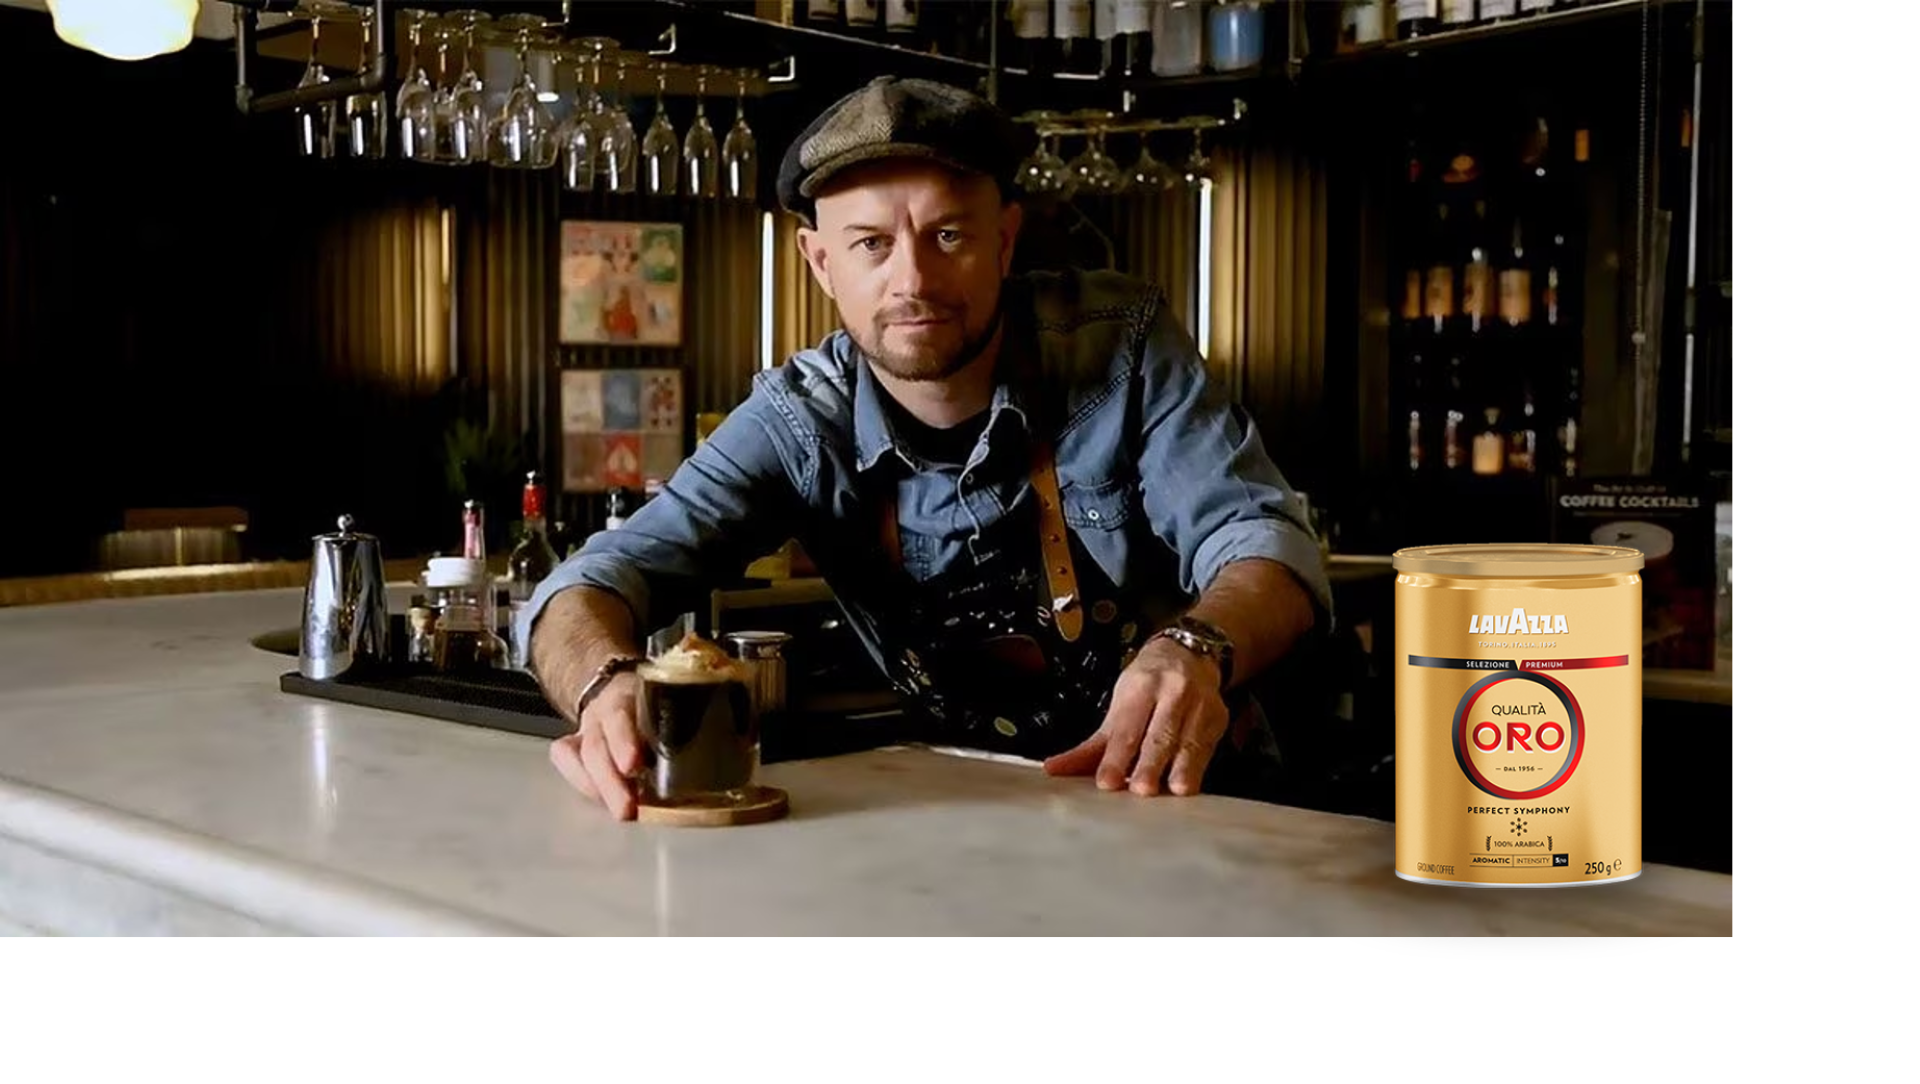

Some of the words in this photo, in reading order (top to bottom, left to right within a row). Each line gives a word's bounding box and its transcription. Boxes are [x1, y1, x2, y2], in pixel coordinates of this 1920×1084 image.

[1559, 495, 1615, 508] COFFEE
[1619, 495, 1699, 508] COCKTAILS
[1468, 608, 1569, 634] LAVAZZA
[1491, 702, 1546, 716] QUALITÀ
[1472, 721, 1566, 753] ORO
[1467, 806, 1510, 815] PERFECT
[1513, 806, 1570, 815] SYMPHONY
[1584, 861, 1605, 875] 250
